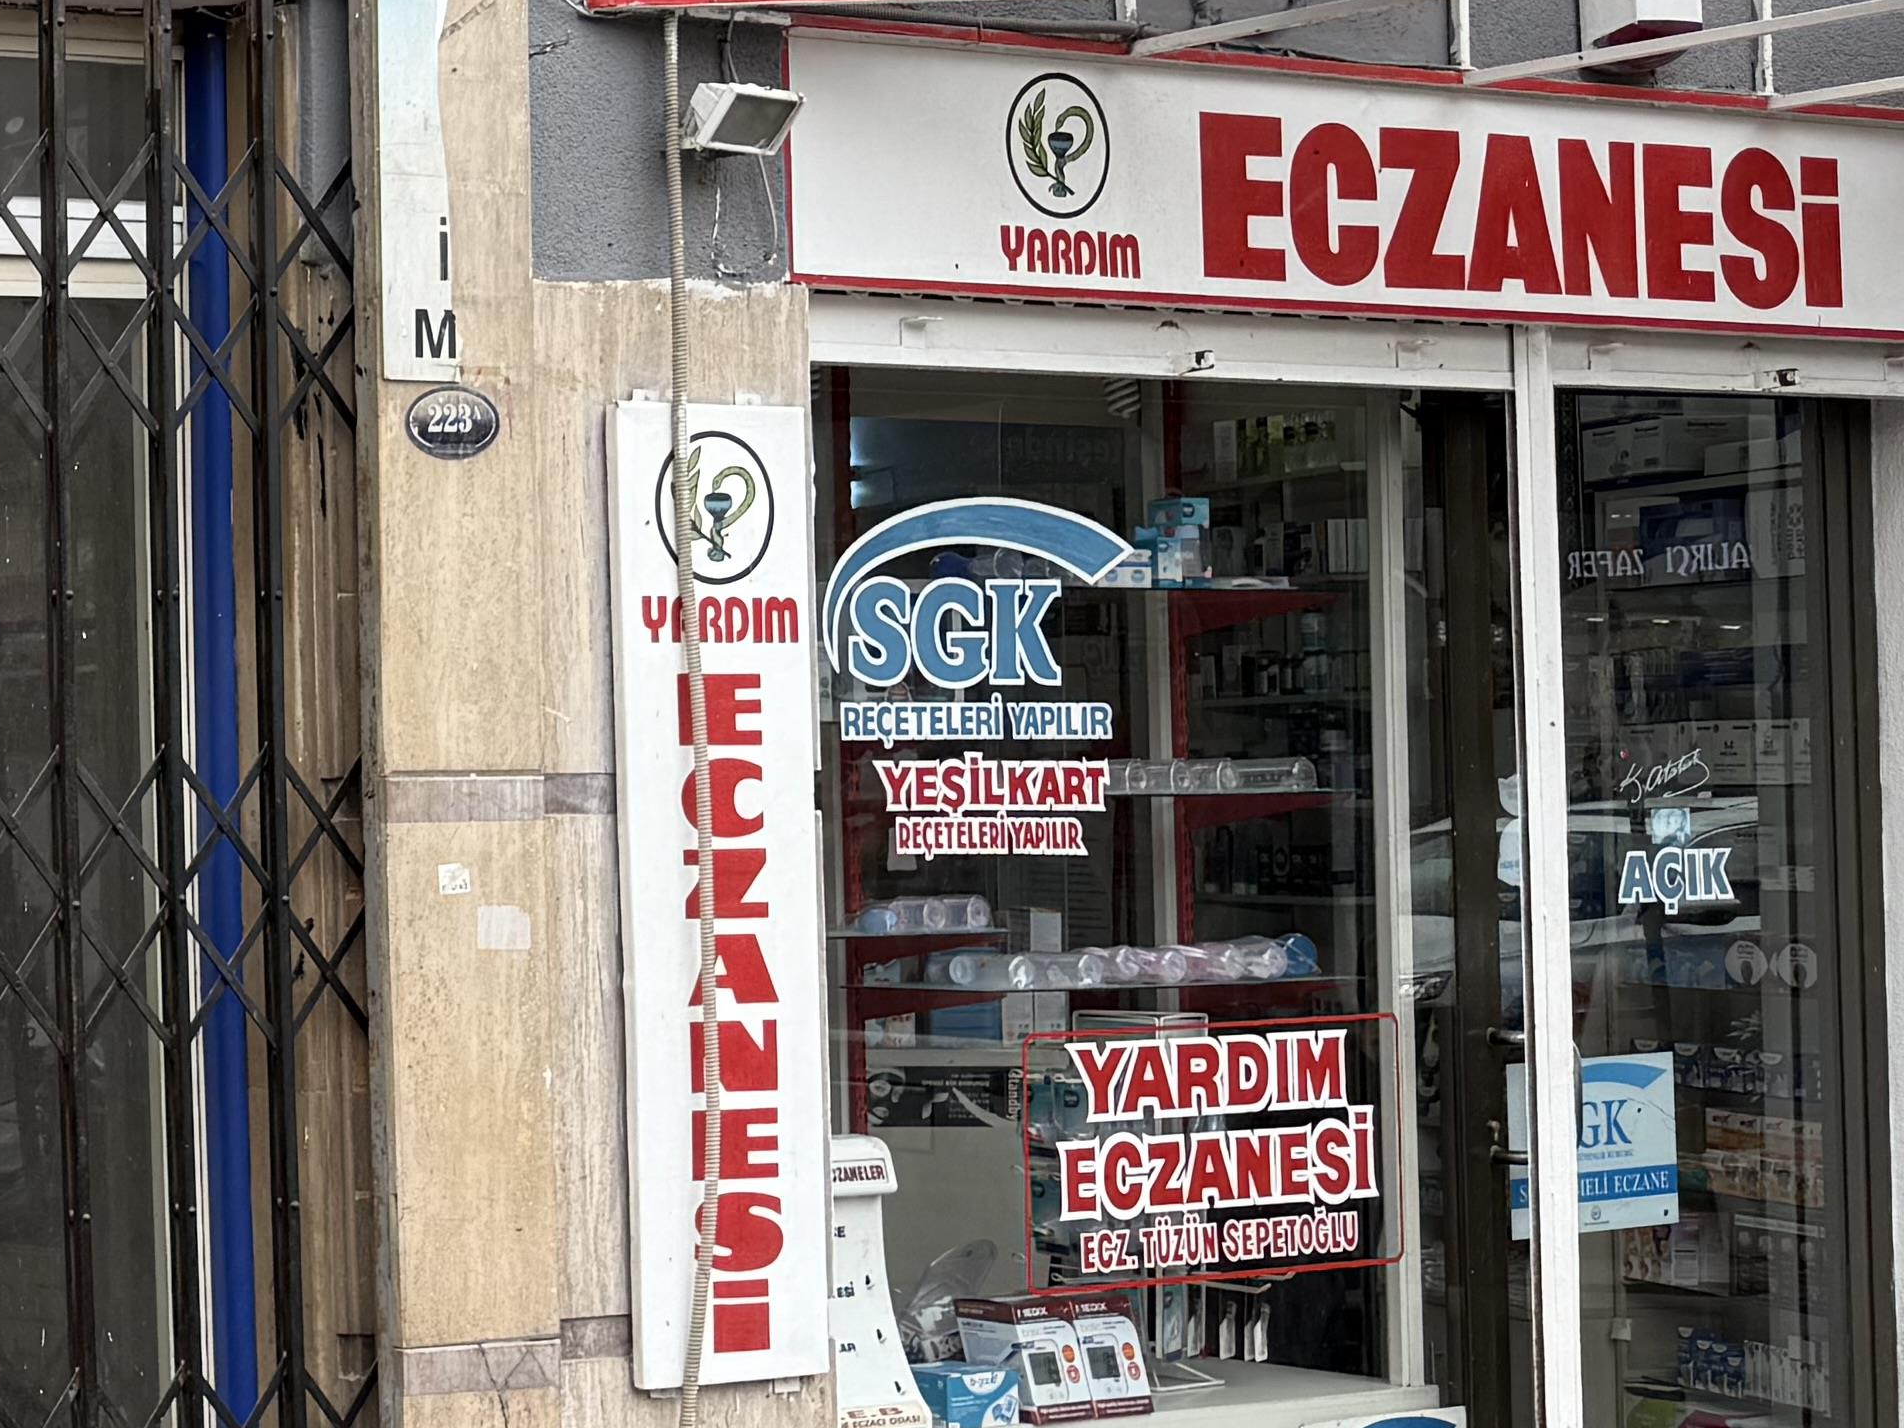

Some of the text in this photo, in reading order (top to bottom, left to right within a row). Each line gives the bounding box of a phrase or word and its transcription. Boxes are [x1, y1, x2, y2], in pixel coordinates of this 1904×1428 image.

[1199, 111, 1843, 310] ECZANESİ
[999, 224, 1141, 280] YARDIM
[848, 575, 1062, 689] SGK
[841, 693, 1112, 748] REÇETELERİ YAPILIR
[875, 752, 1109, 815] YEŞİLKART
[896, 812, 1086, 860] REÇETELERİ YAPILIR
[1618, 848, 1734, 914] AÇIK
[677, 672, 784, 1355] ECZANESİ
[1069, 1031, 1346, 1118] YARDIM
[1579, 1098, 1633, 1149] GK
[832, 1164, 886, 1183] ZANELER
[1060, 1107, 1378, 1218] ECZANESİ
[1081, 1207, 1359, 1274] ECZ. TÜZÜN SEPETOĞLU
